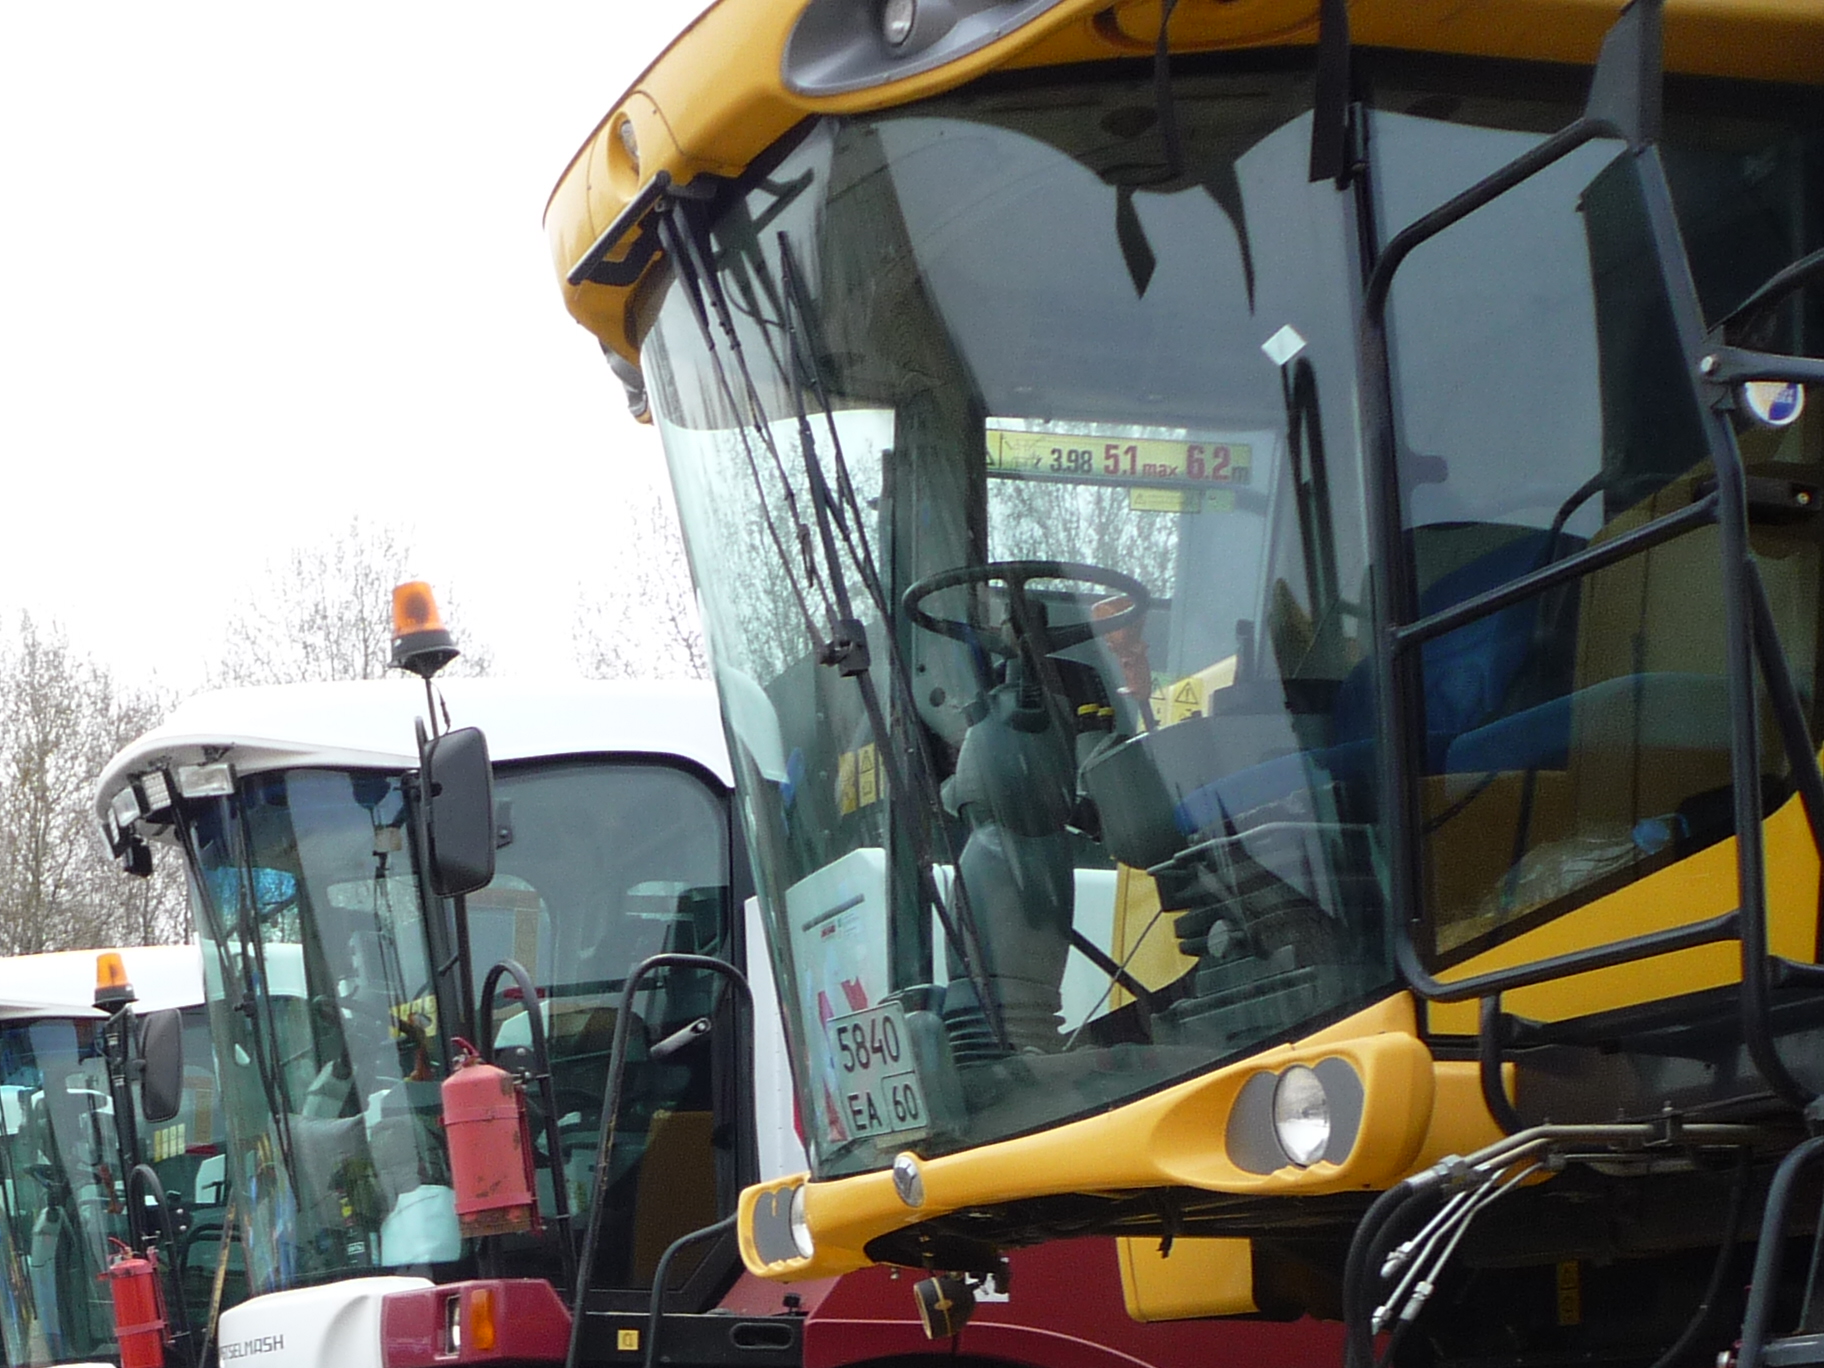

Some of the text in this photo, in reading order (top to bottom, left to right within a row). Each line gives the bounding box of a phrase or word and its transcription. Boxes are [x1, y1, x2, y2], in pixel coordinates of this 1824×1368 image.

[1049, 447, 1093, 475] 3.98
[1142, 463, 1178, 480] max
[1185, 444, 1231, 482] 6.2
[837, 1015, 900, 1073] 5840
[892, 1083, 918, 1123] 60
